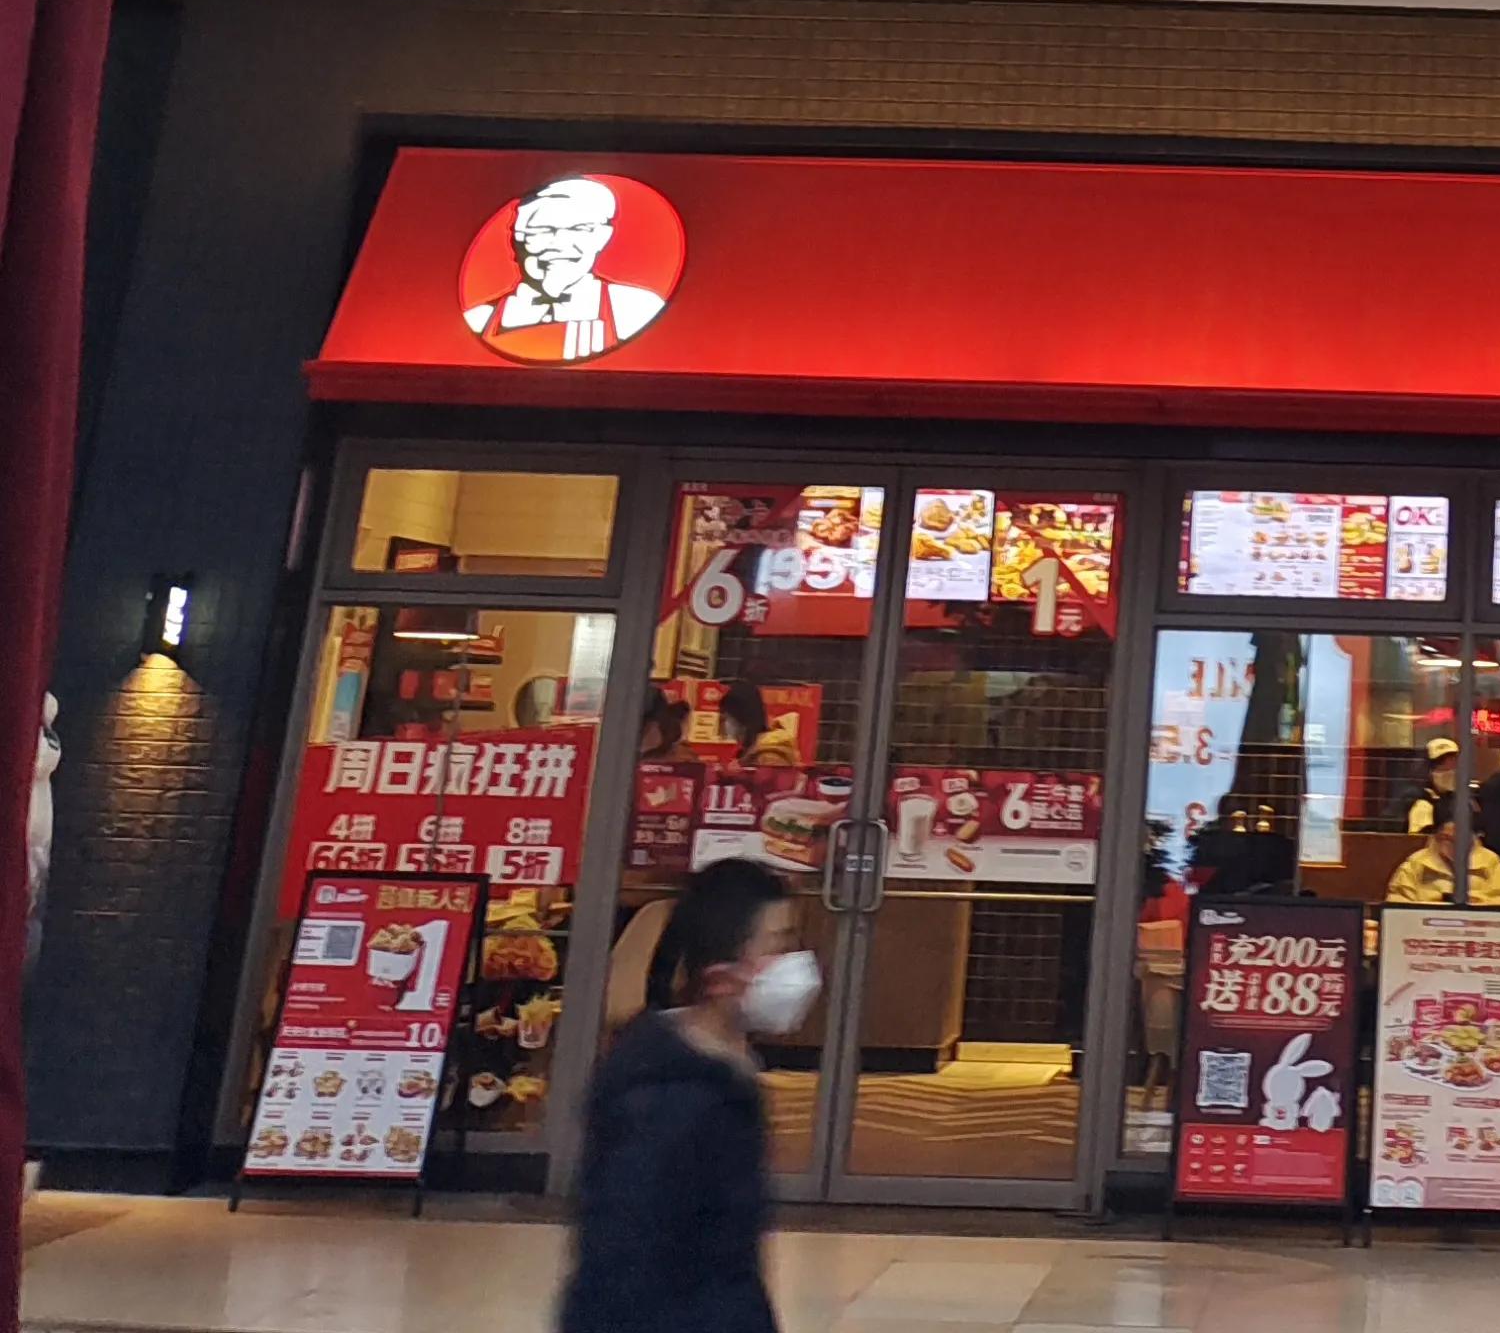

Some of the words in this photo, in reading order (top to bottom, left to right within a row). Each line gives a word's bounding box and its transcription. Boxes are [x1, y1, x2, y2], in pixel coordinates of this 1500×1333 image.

[324, 741, 577, 798] 周日疯狂拼
[1226, 934, 1347, 968] 充200元
[1199, 969, 1245, 1013] 送
